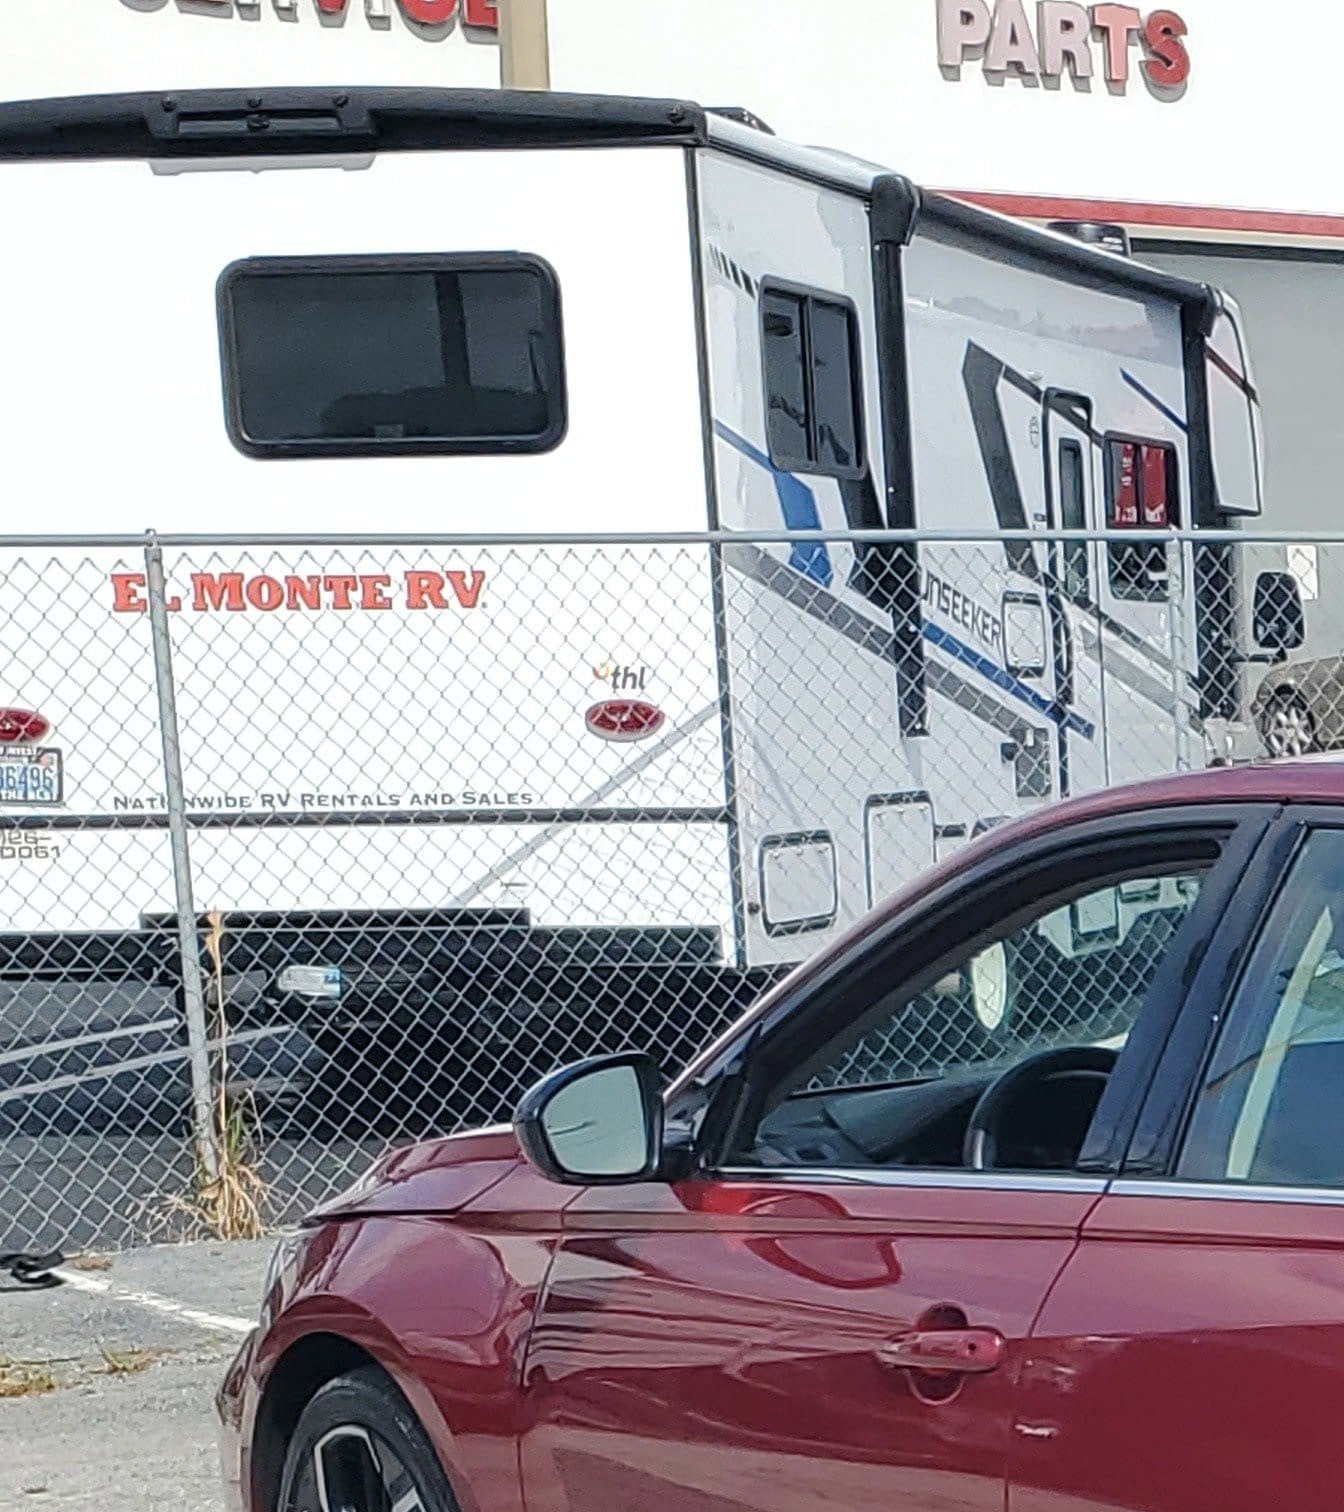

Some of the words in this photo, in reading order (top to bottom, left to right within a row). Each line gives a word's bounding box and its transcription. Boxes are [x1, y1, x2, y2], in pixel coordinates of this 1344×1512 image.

[936, 0, 1190, 99] PARTS
[190, 571, 393, 612] MONTE
[404, 570, 486, 610] RV
[113, 795, 253, 810] NATINWIDE
[261, 793, 292, 808] RV
[300, 793, 401, 808] RENTALS
[410, 794, 455, 807] AND
[461, 791, 534, 807] SALES
